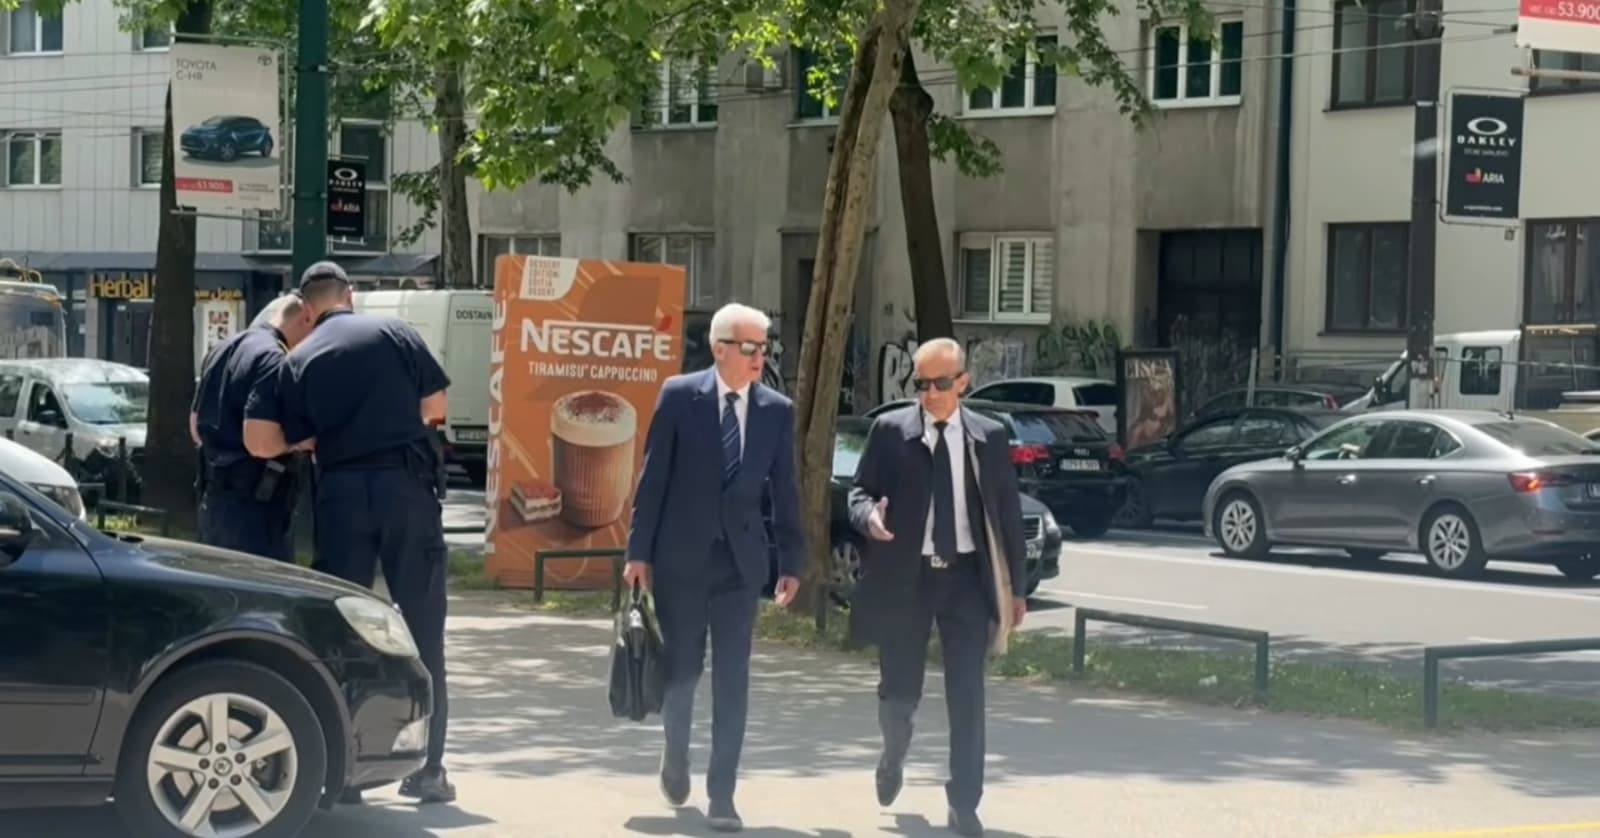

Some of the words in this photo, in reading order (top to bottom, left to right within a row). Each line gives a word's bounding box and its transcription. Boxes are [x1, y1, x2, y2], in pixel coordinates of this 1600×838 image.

[176, 58, 217, 71] TOYOTA
[1457, 135, 1516, 147] OAKLEY
[1482, 172, 1505, 184] ARIA
[89, 272, 149, 299] Herbal
[590, 365, 658, 383] CAPPUCCINO
